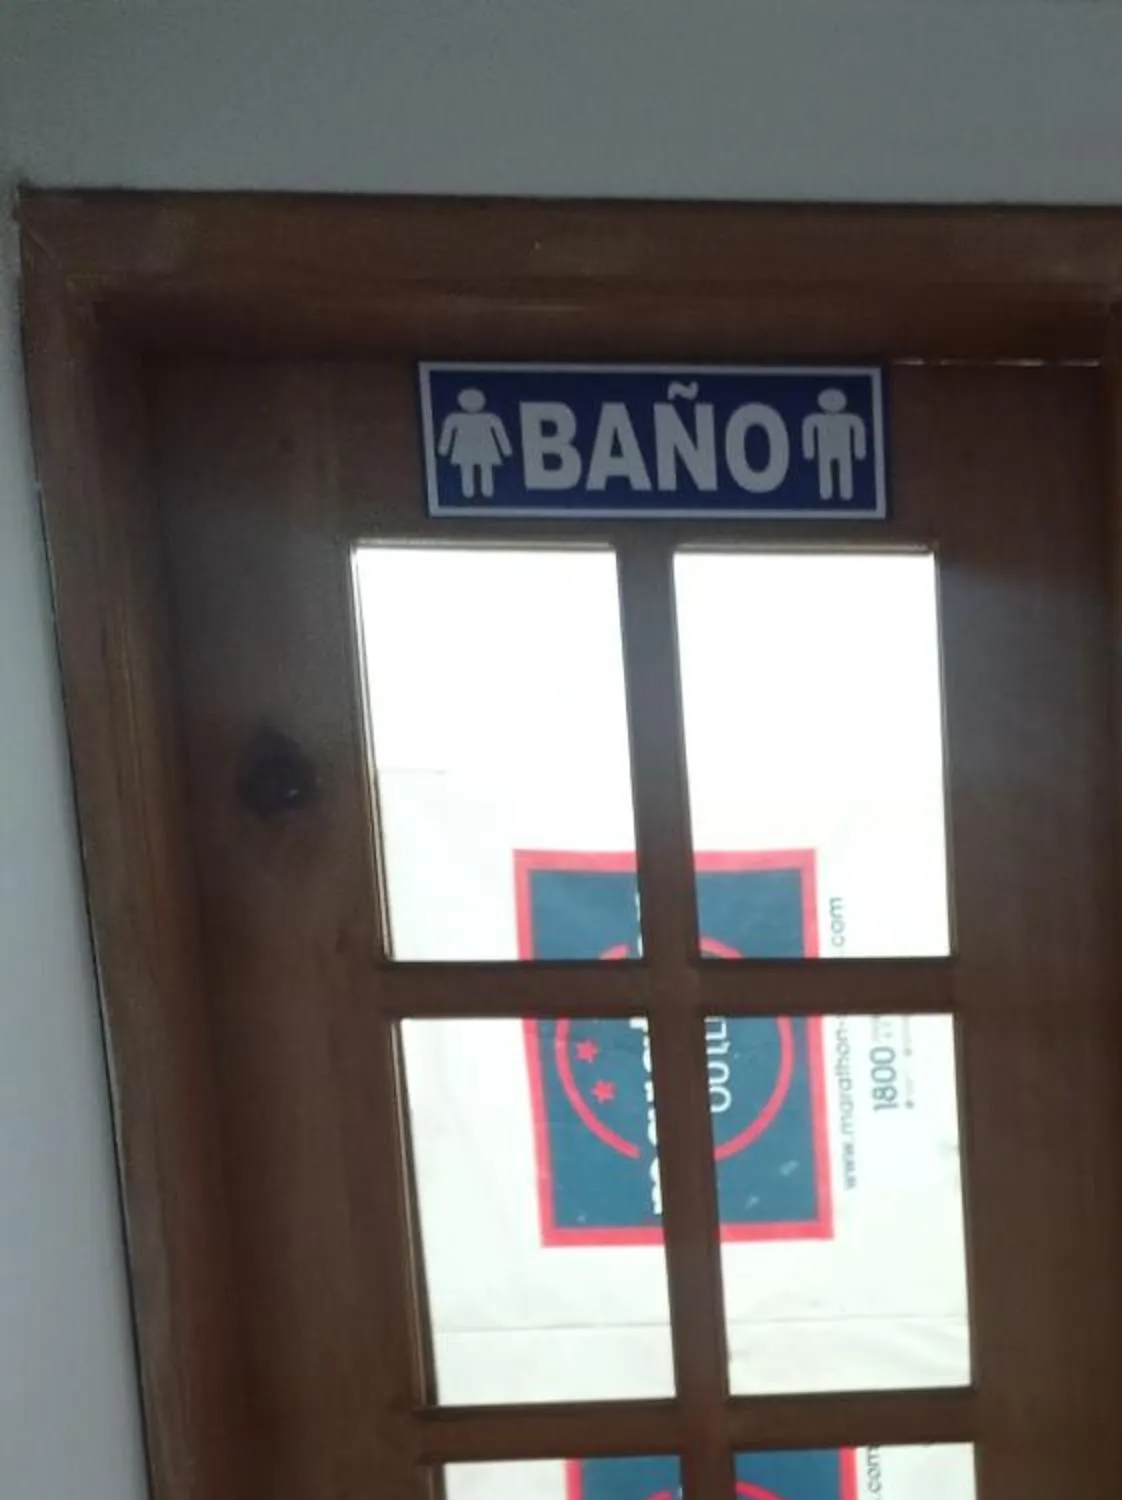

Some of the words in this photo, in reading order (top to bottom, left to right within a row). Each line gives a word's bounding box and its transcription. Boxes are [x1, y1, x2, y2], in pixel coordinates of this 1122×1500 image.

[520, 381, 790, 493] BAÑO
[704, 1016, 732, 1113] OUTL
[869, 1046, 900, 1112] 1800
